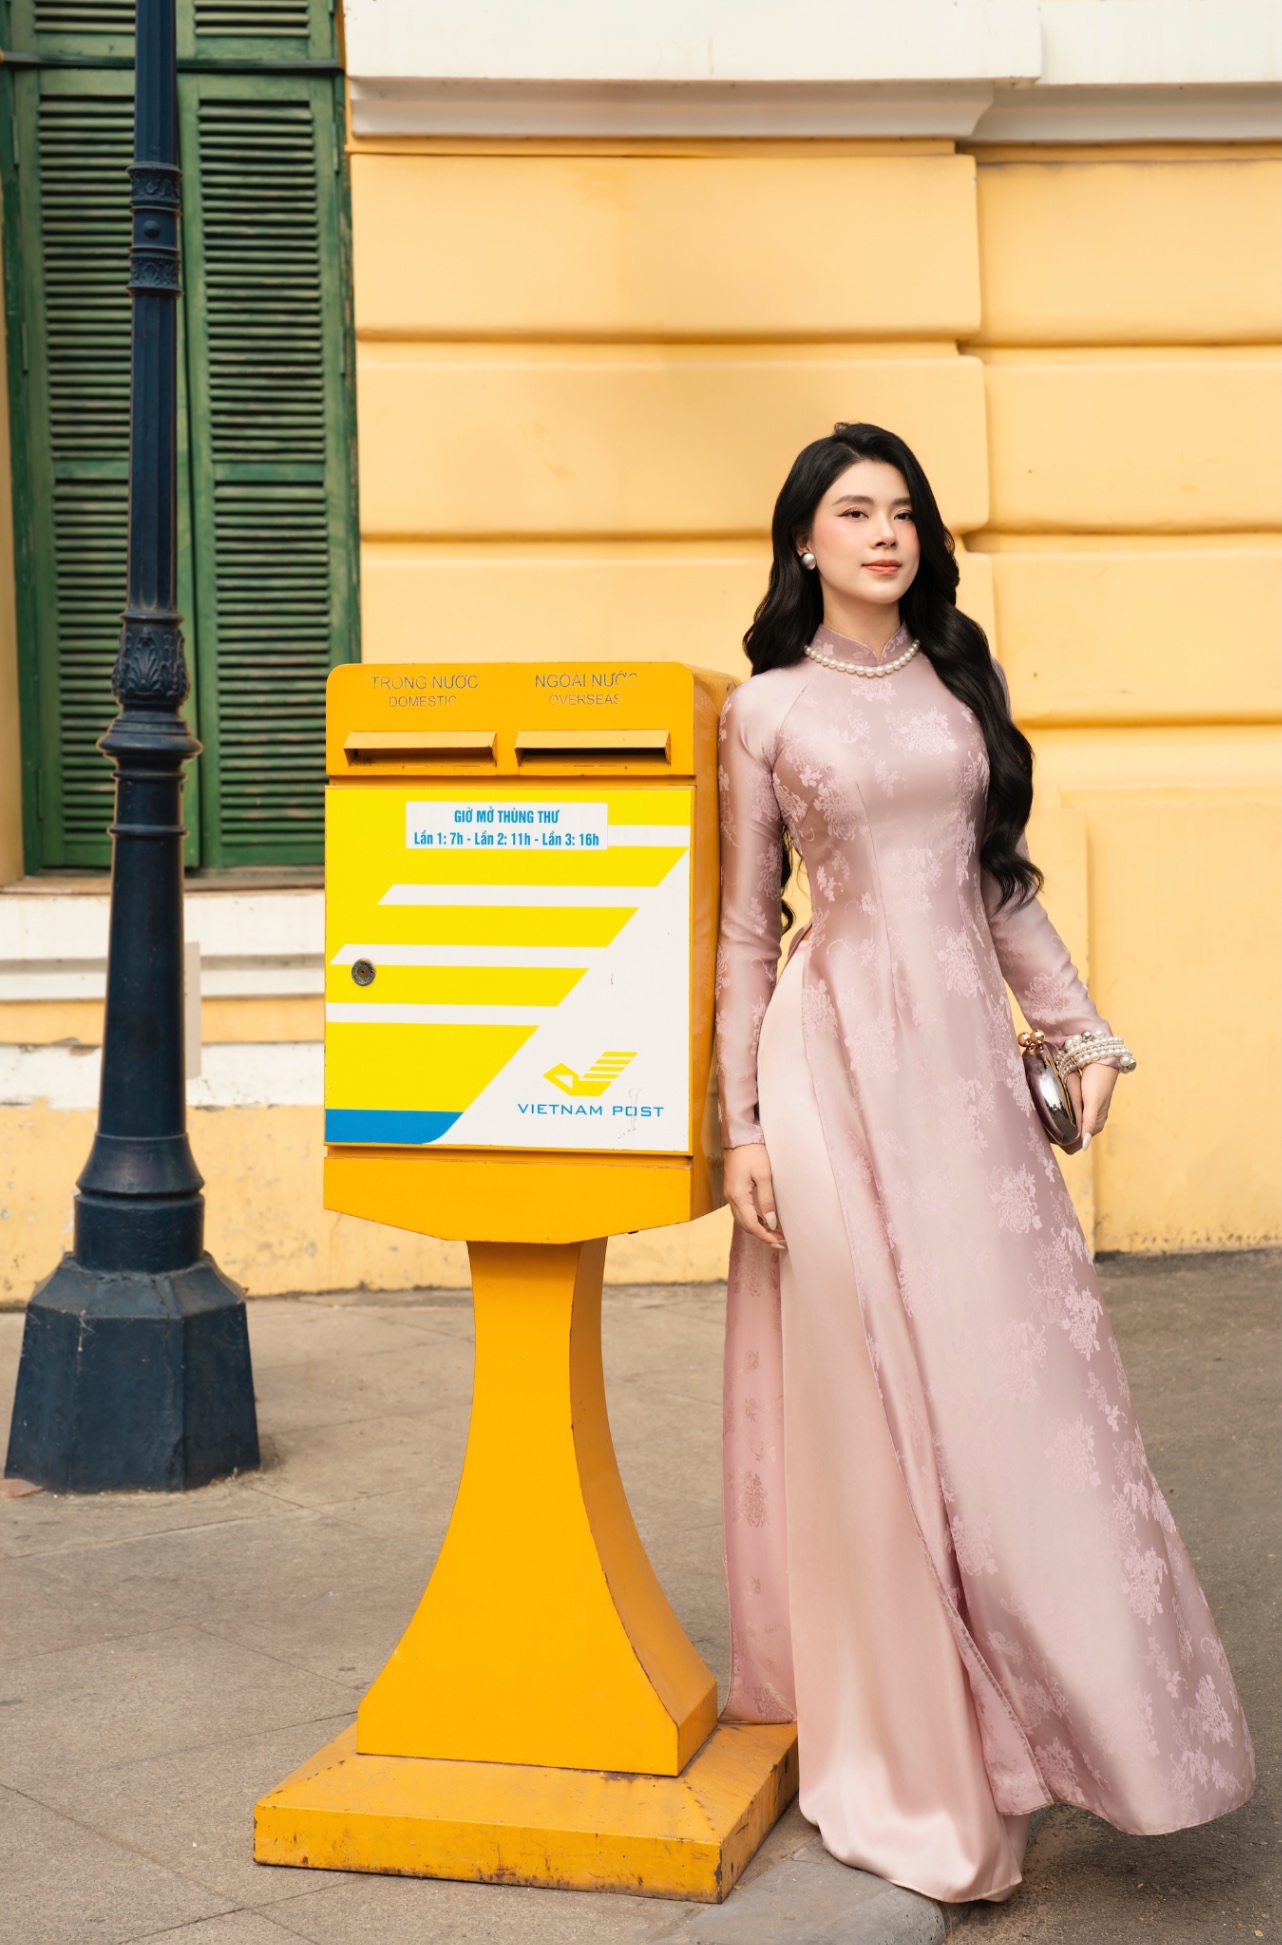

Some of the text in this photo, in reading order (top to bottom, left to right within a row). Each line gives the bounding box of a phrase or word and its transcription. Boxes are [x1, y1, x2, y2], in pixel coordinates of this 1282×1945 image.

[371, 673, 479, 690] TRONG NƯỚC
[535, 671, 586, 688] NGOÀI
[388, 695, 457, 707] DOMESTIC
[549, 693, 620, 705] OVERSEAS
[454, 805, 560, 823] GIỜ MỞ THÙNG THƯ
[414, 829, 433, 845] Lần
[437, 832, 447, 845] 1:
[450, 832, 464, 845] 7h
[474, 830, 494, 845] Lần
[497, 832, 507, 845] 2:
[511, 832, 531, 845] 11h
[542, 830, 562, 846] Lần
[565, 833, 575, 846] 3:
[579, 833, 599, 846] 16h
[517, 1103, 665, 1118] VIETNAM POST
